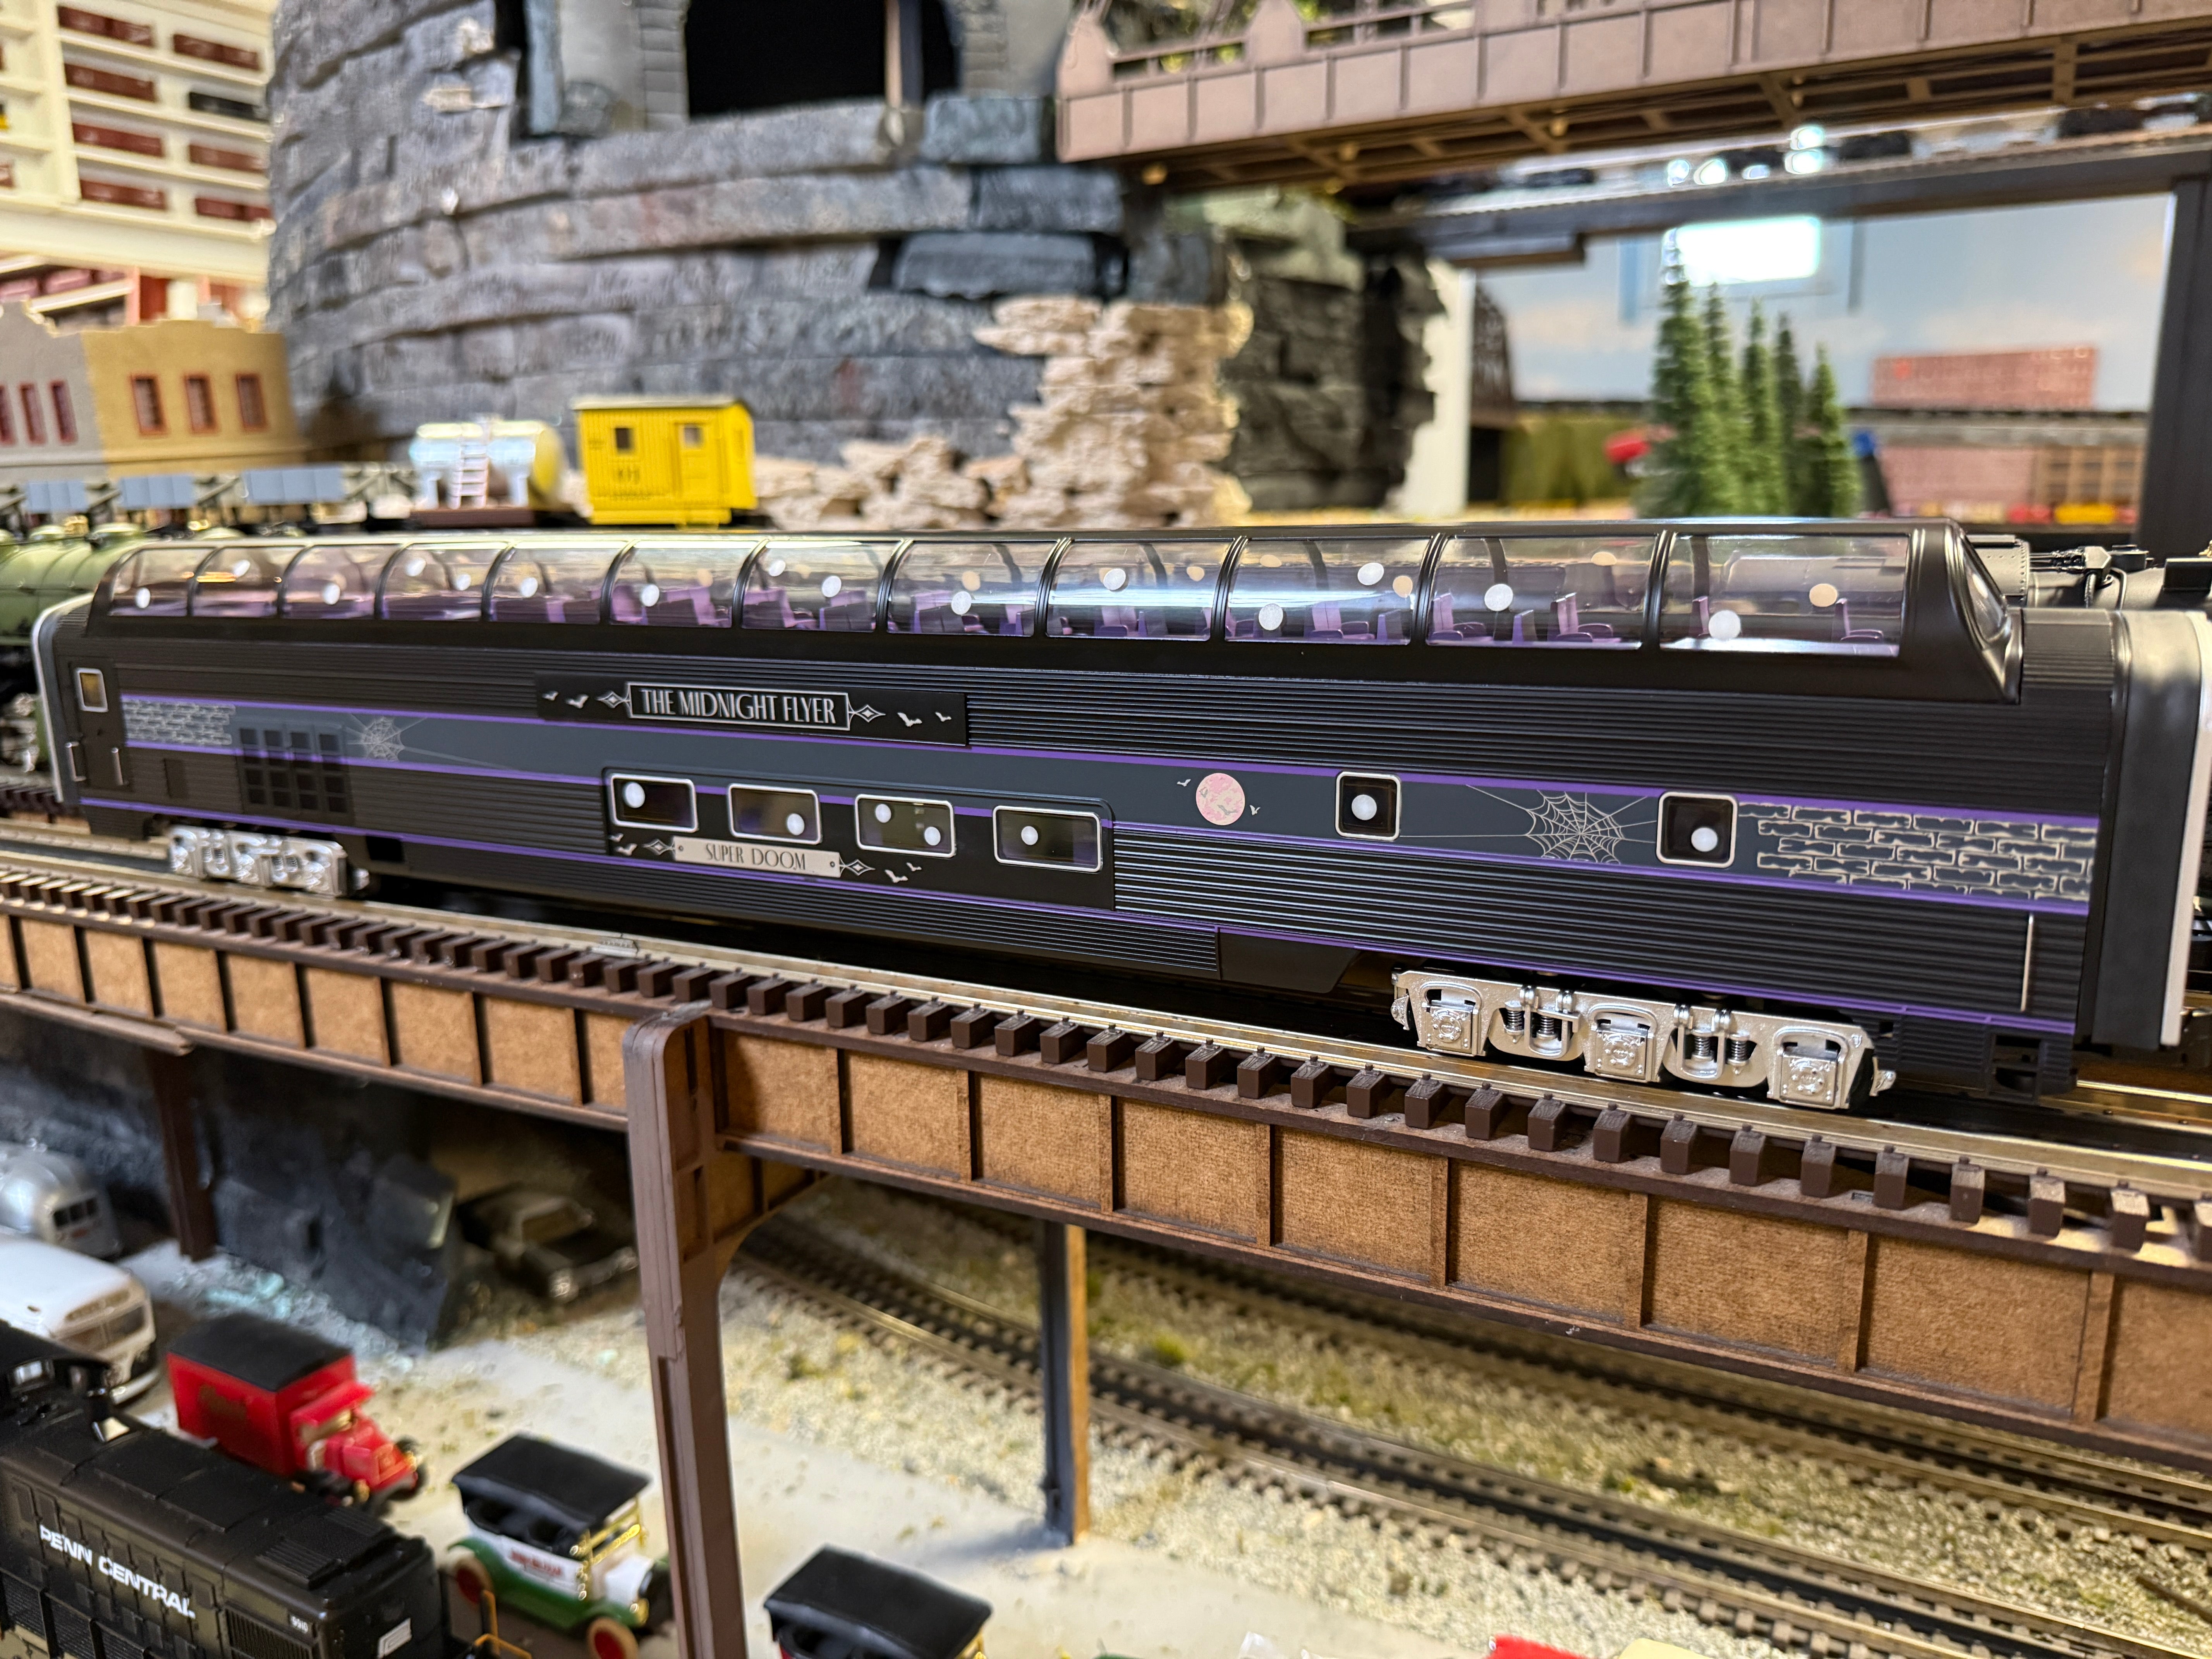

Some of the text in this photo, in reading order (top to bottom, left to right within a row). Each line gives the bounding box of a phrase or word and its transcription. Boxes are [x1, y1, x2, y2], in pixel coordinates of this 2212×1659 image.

[639, 688, 836, 724] THE MIDNIGHT FLYER
[706, 842, 805, 870] SUPER DOOM
[40, 1524, 196, 1620] PENN CENTRAL
